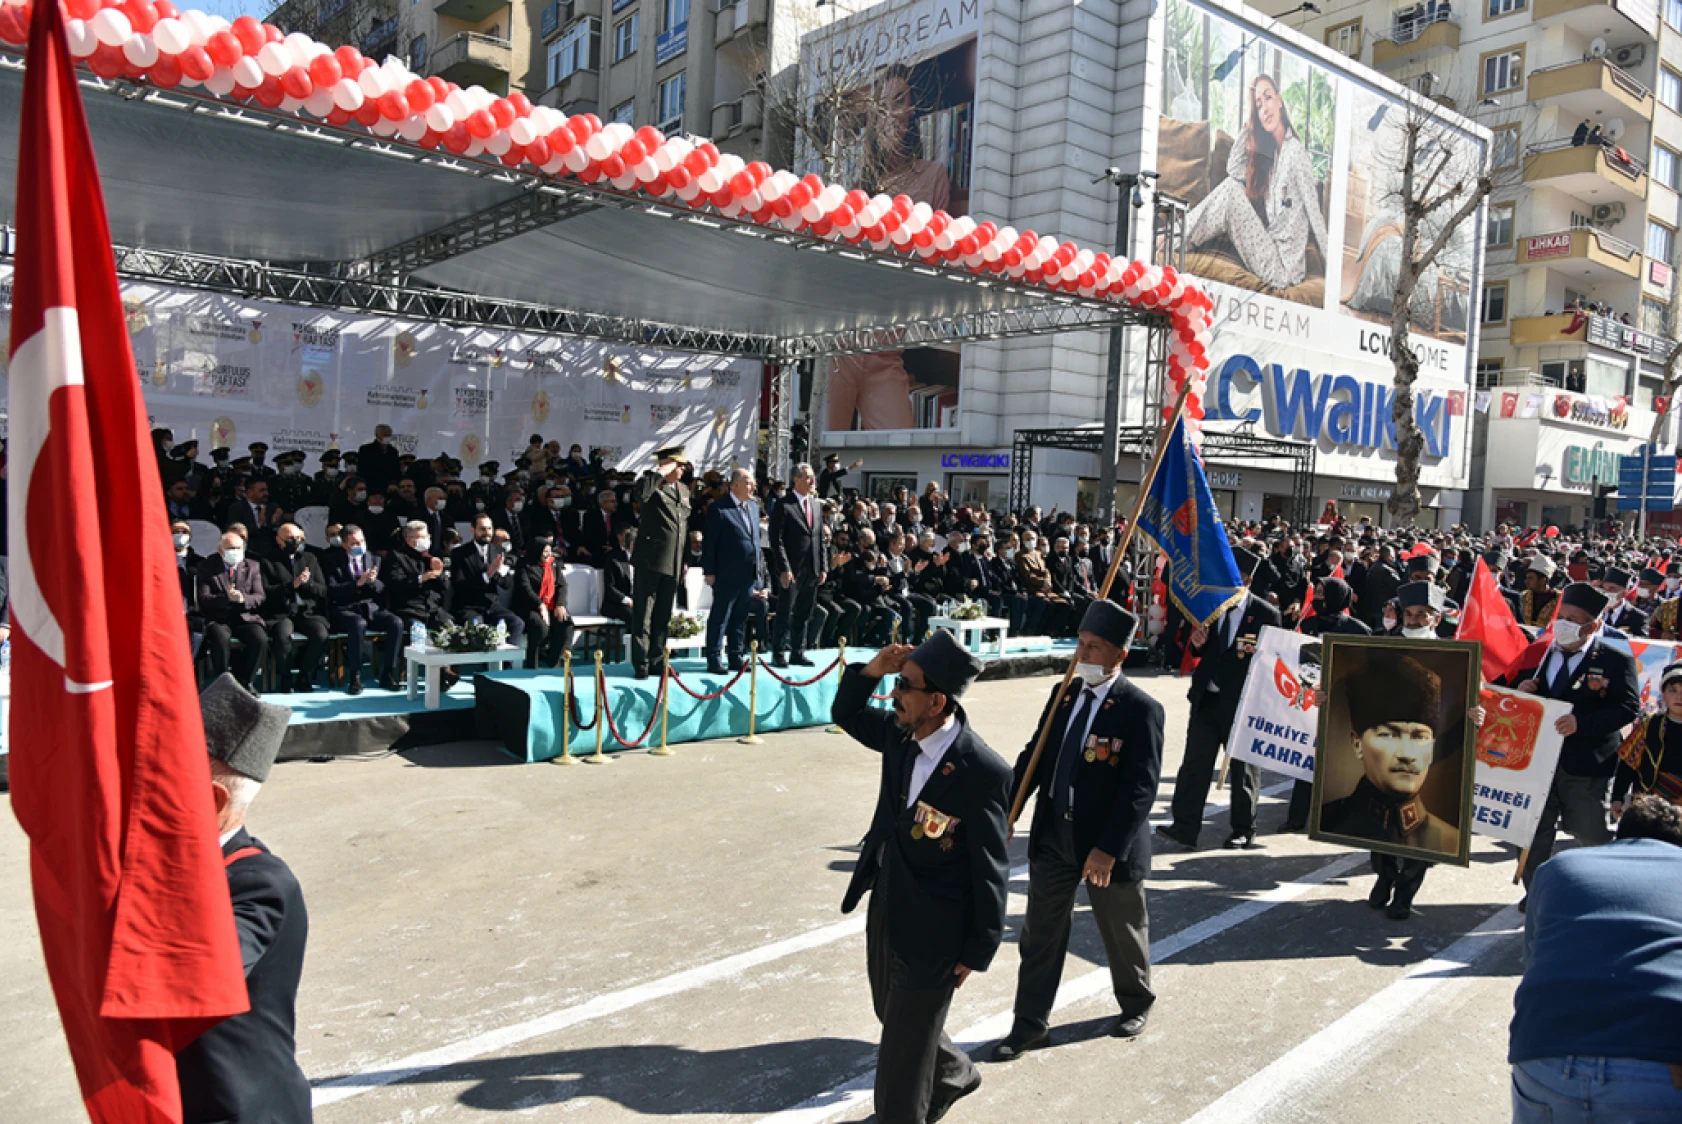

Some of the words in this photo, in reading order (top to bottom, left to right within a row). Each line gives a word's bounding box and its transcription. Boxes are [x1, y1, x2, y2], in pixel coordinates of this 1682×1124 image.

[875, 0, 978, 57] DREAM
[1227, 297, 1310, 338] DREAM
[1409, 342, 1448, 371] OME
[1247, 715, 1310, 745] TÜRKİYE
